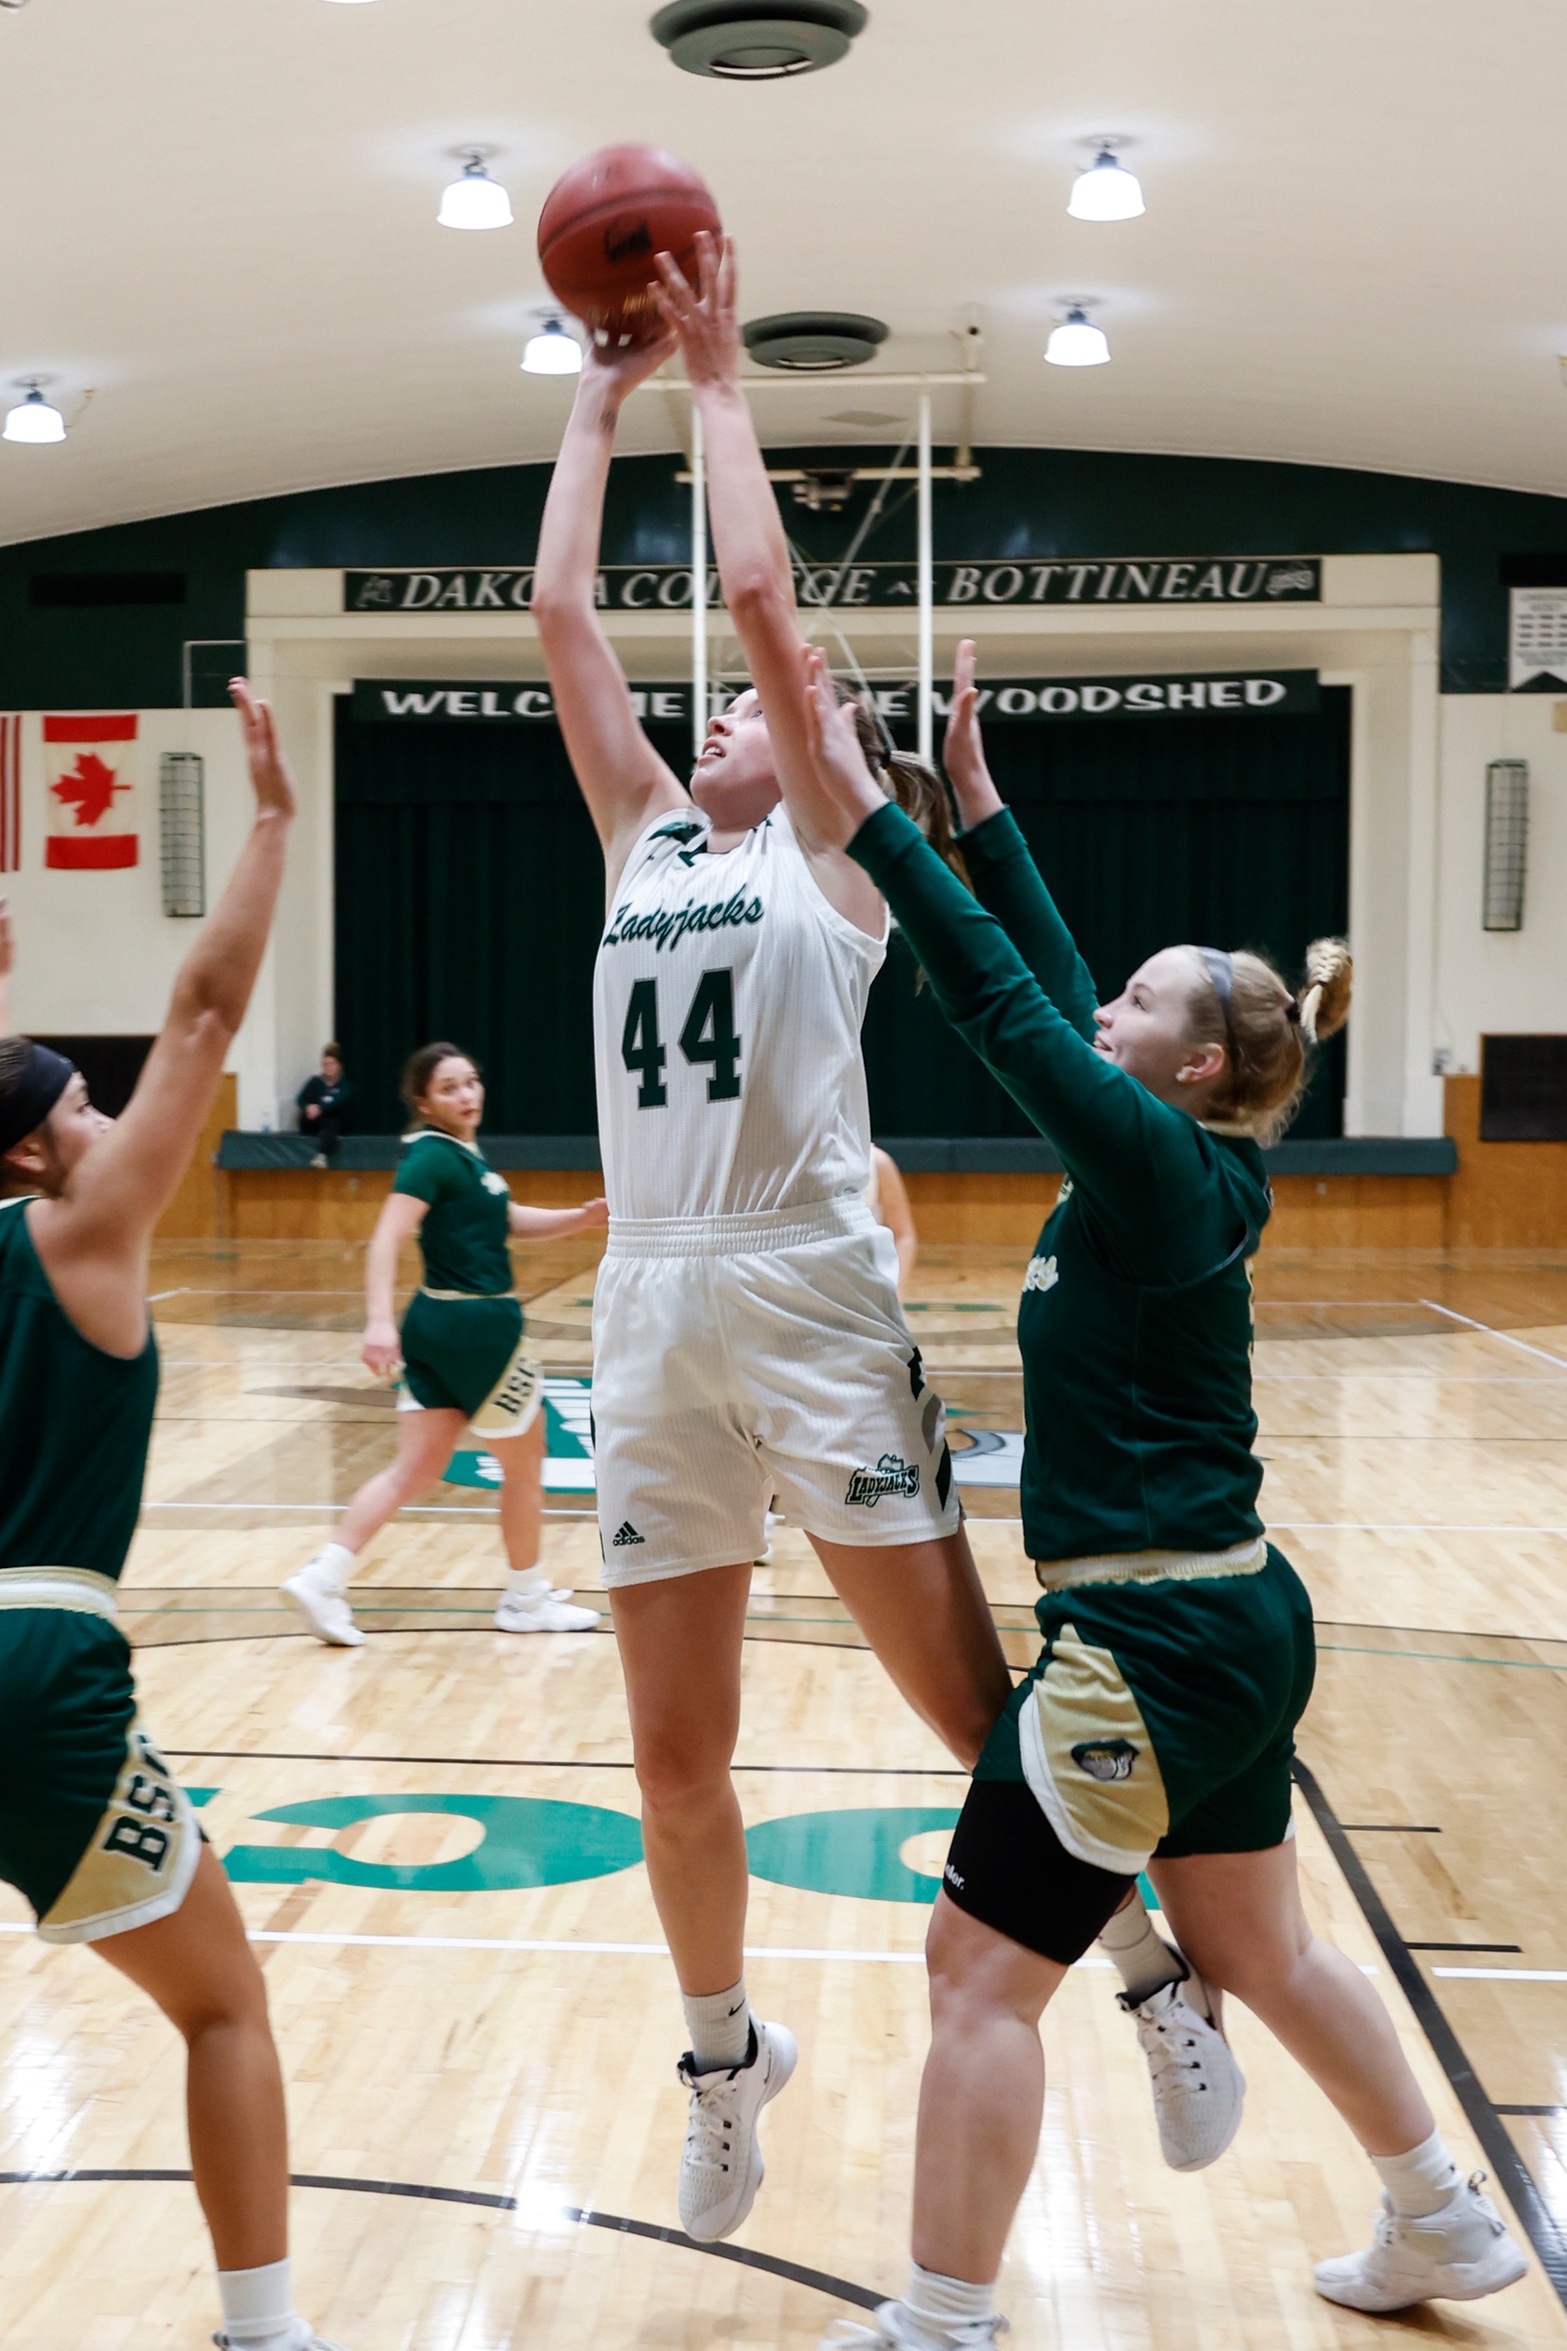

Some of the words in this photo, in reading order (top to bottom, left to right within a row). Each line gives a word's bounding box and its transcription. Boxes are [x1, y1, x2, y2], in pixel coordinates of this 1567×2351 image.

[402, 572, 609, 608] DAKOA
[620, 569, 875, 608] COLGE
[946, 562, 1268, 602] BOTTINEAU
[382, 689, 685, 718] WELCE
[602, 882, 764, 951] Ladyjacks
[620, 965, 744, 1111] 44
[846, 1465, 919, 1503] LADYJACKS
[612, 1535, 646, 1547] adidas
